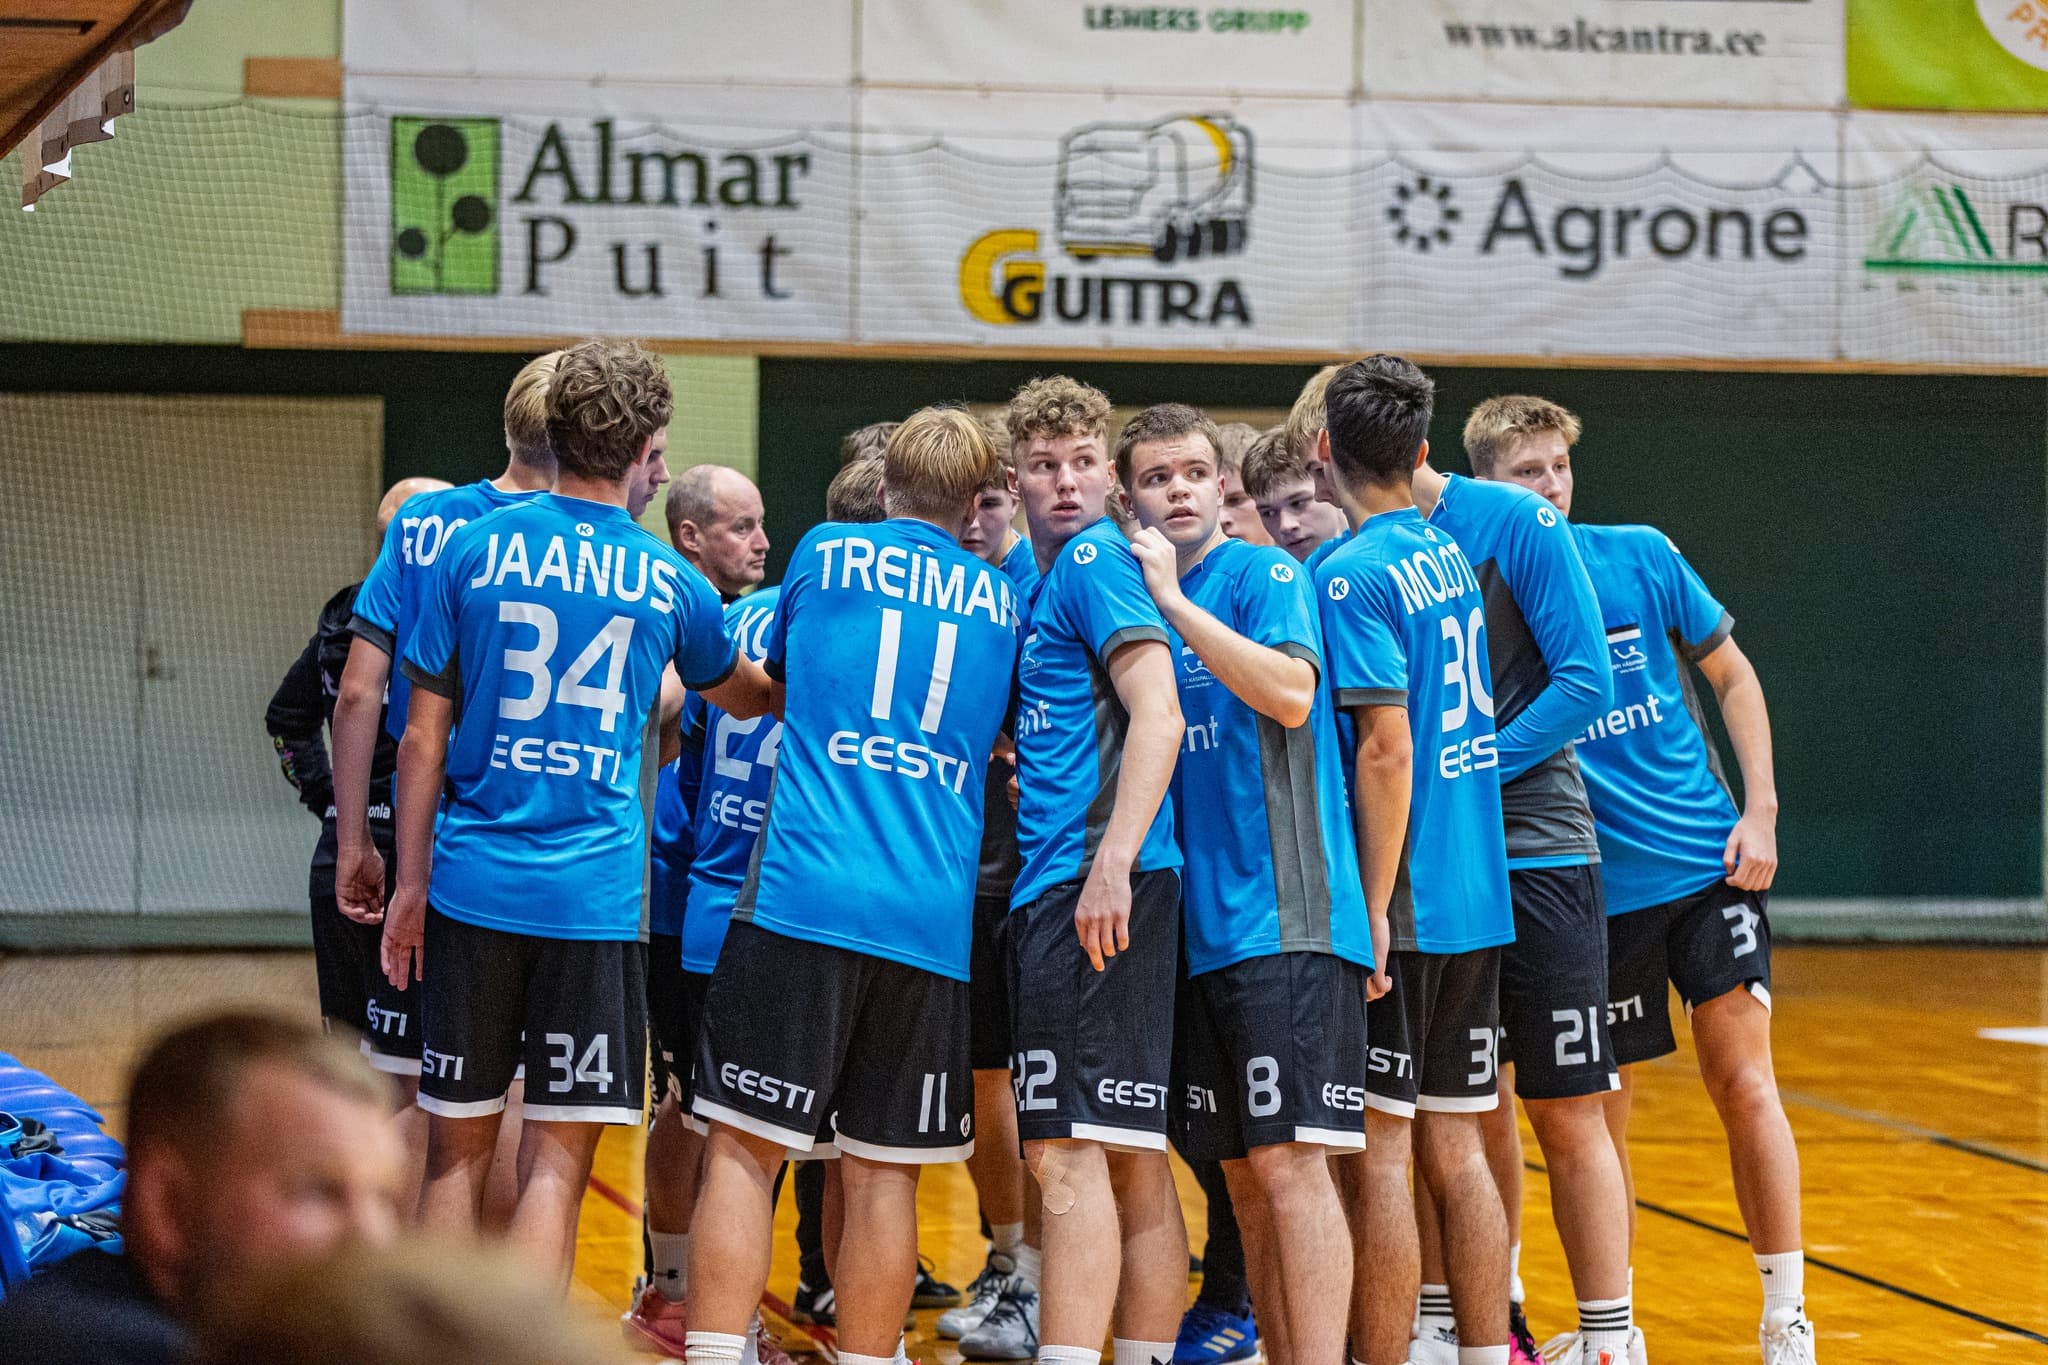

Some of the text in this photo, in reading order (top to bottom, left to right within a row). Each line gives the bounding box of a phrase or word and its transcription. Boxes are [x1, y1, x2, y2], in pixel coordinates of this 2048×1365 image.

[1444, 17, 1767, 56] www.alcantra.ee
[514, 118, 811, 209] Almar
[520, 216, 794, 299] Puit
[1480, 177, 1808, 278] Agrone
[471, 532, 679, 615] JAANUS
[1386, 542, 1480, 616] MOLOT
[498, 601, 636, 733] 34
[871, 608, 958, 735] 11
[490, 734, 621, 784] EESTI
[827, 730, 969, 795] EESTI
[422, 1042, 464, 1081] STI
[545, 1033, 613, 1093] 34
[1467, 1027, 1499, 1086] 3
[1551, 1006, 1598, 1067] 21
[721, 1062, 816, 1114] EESTI
[917, 1072, 948, 1133] 11
[1247, 1056, 1282, 1117] 8
